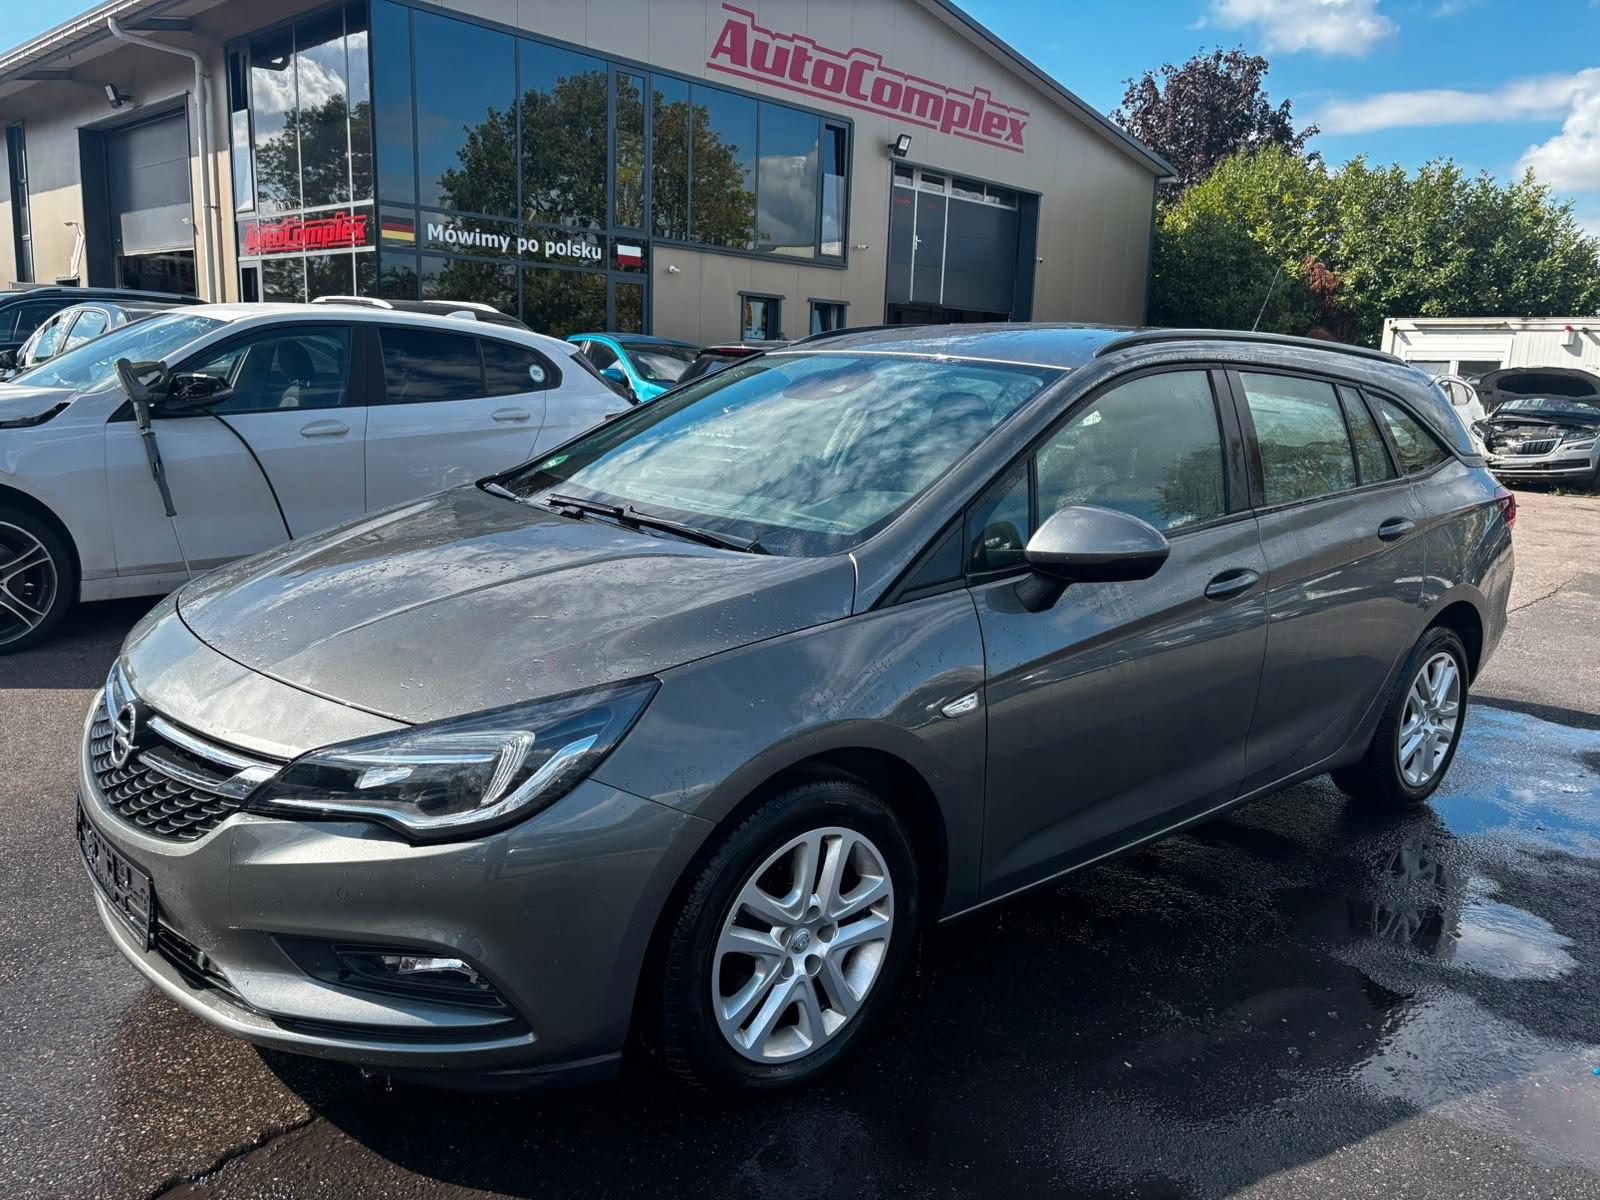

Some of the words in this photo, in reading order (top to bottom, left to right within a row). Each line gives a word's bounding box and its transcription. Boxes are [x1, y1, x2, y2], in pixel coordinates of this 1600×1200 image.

[710, 19, 1028, 145] AutoComplex
[427, 223, 511, 253] Mówimy
[517, 237, 539, 254] po
[545, 240, 602, 260] polsku
